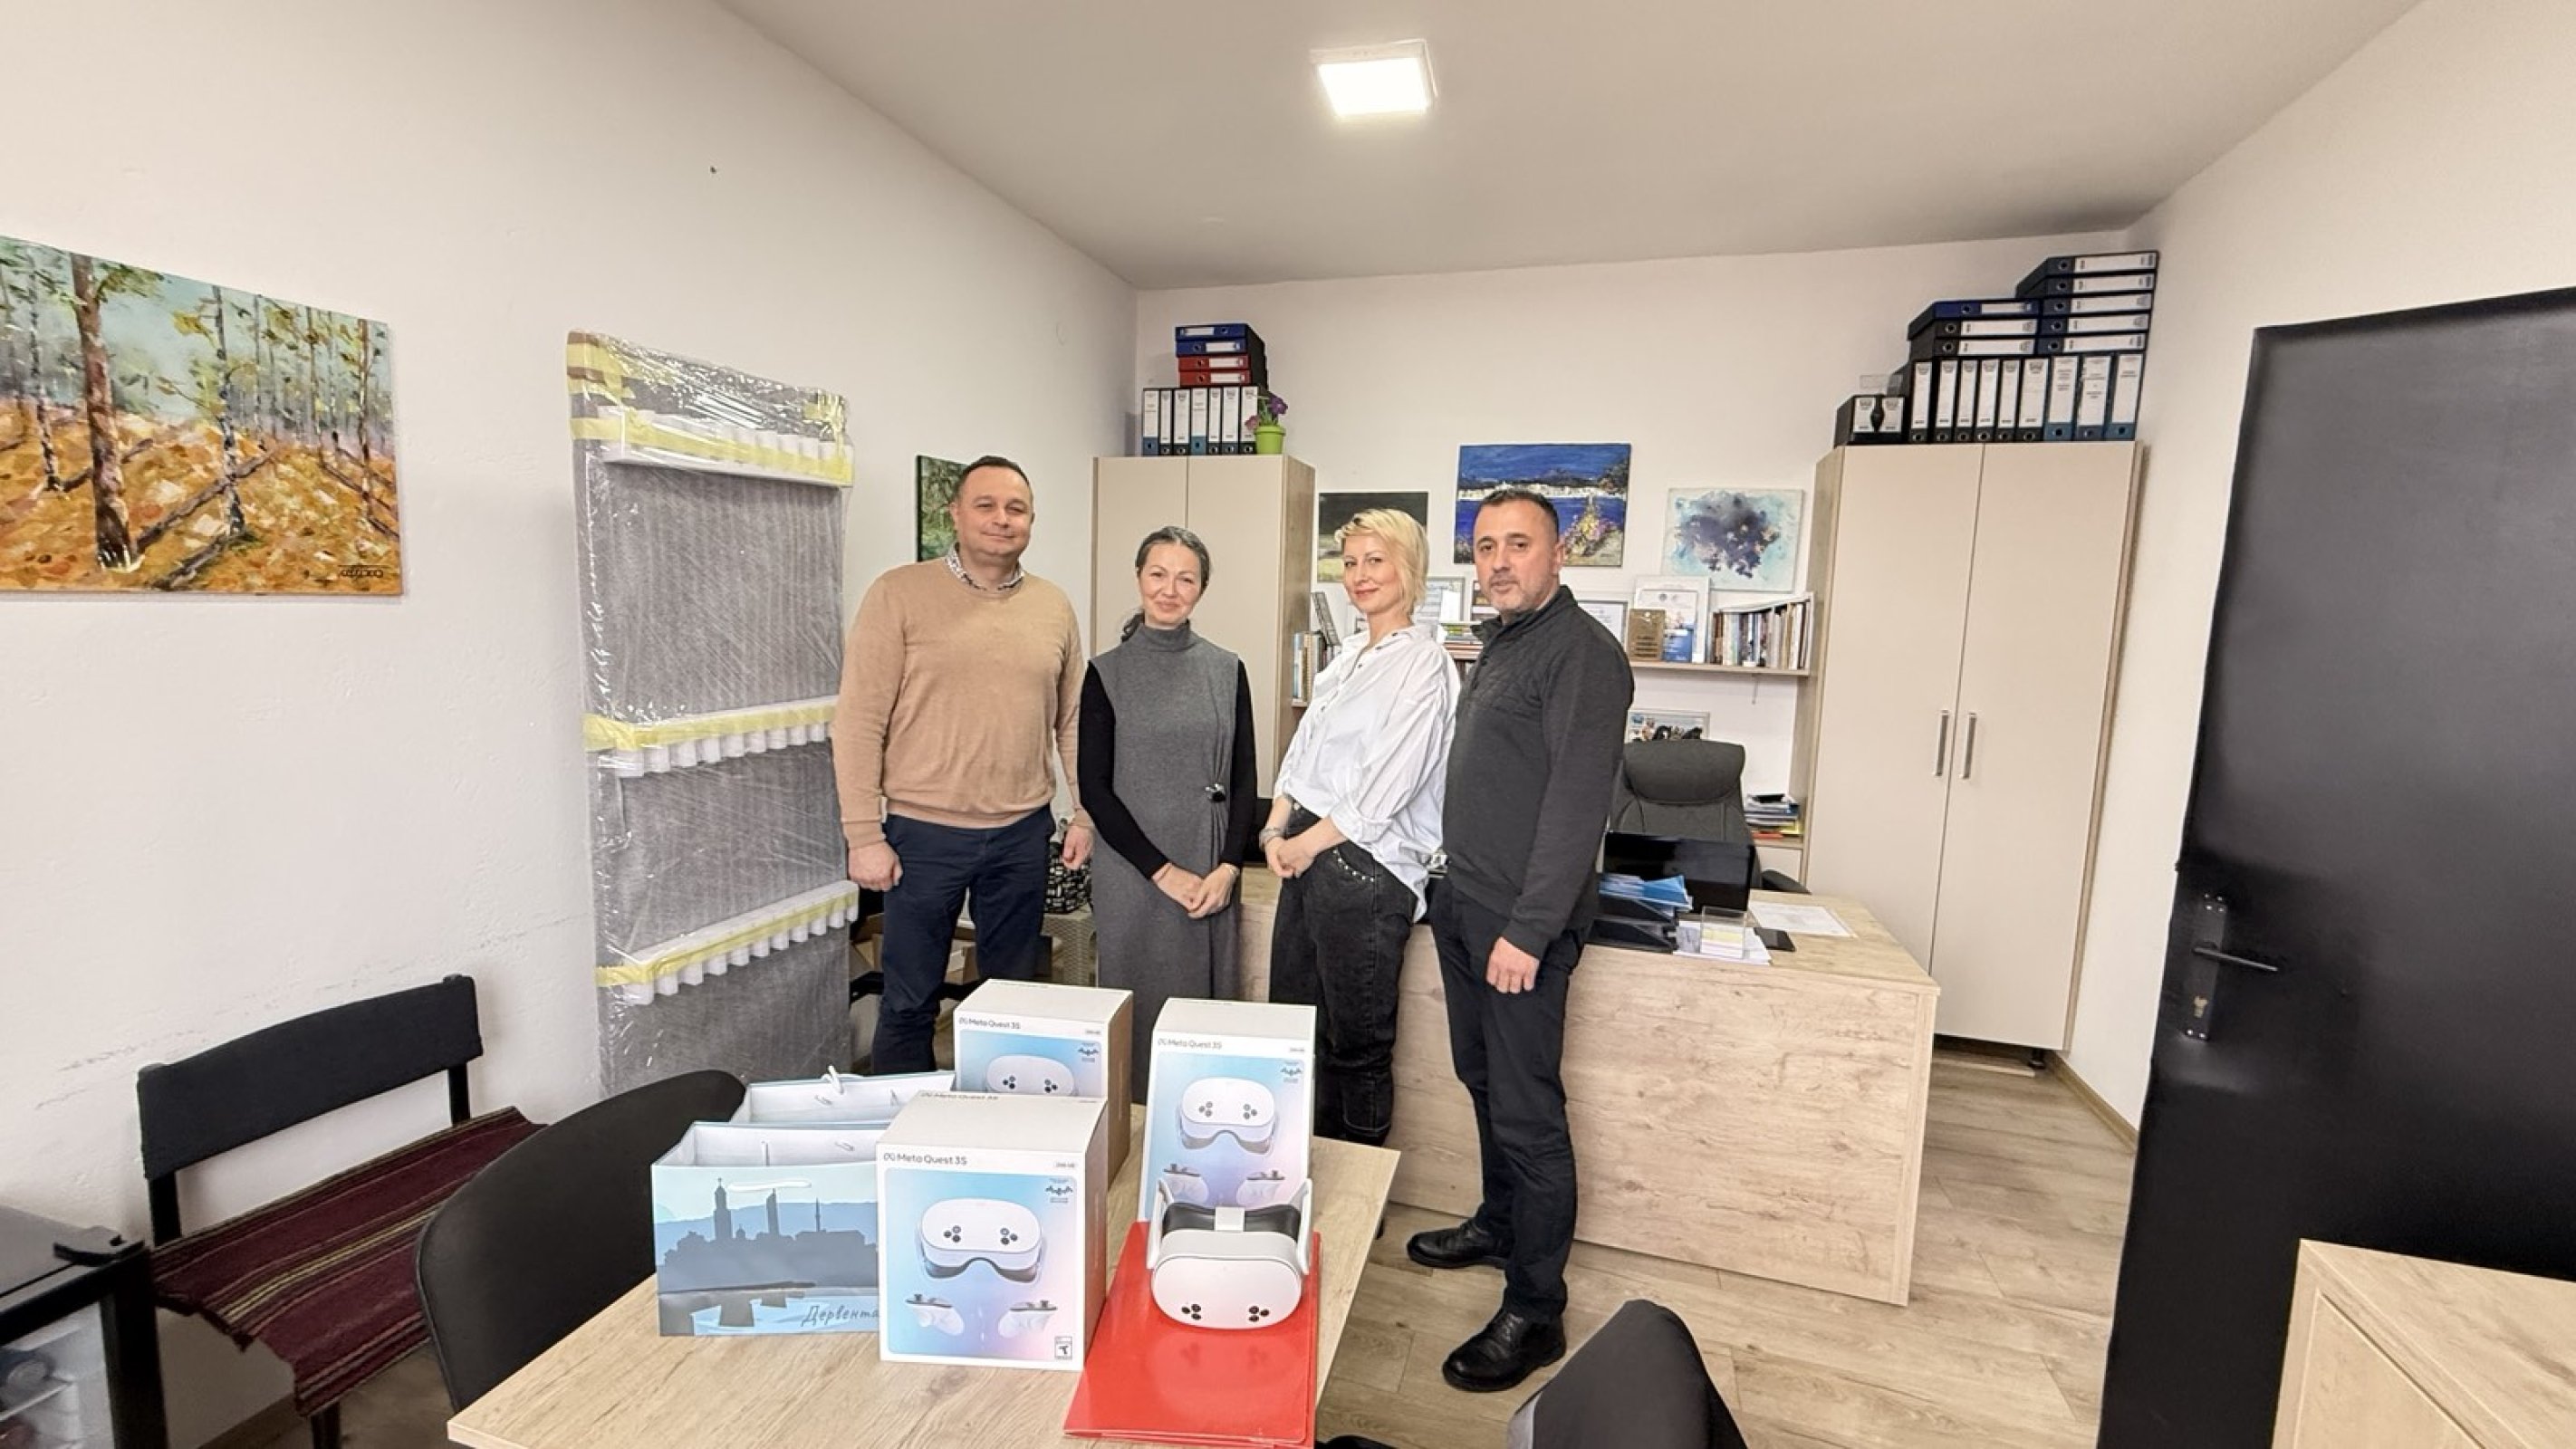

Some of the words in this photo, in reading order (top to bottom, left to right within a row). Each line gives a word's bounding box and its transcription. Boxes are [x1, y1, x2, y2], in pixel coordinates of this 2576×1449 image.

[988, 1019, 1010, 1028] Quest
[897, 1152, 923, 1163] Meta
[924, 1154, 954, 1165] Quest
[955, 1155, 967, 1166] 3S
